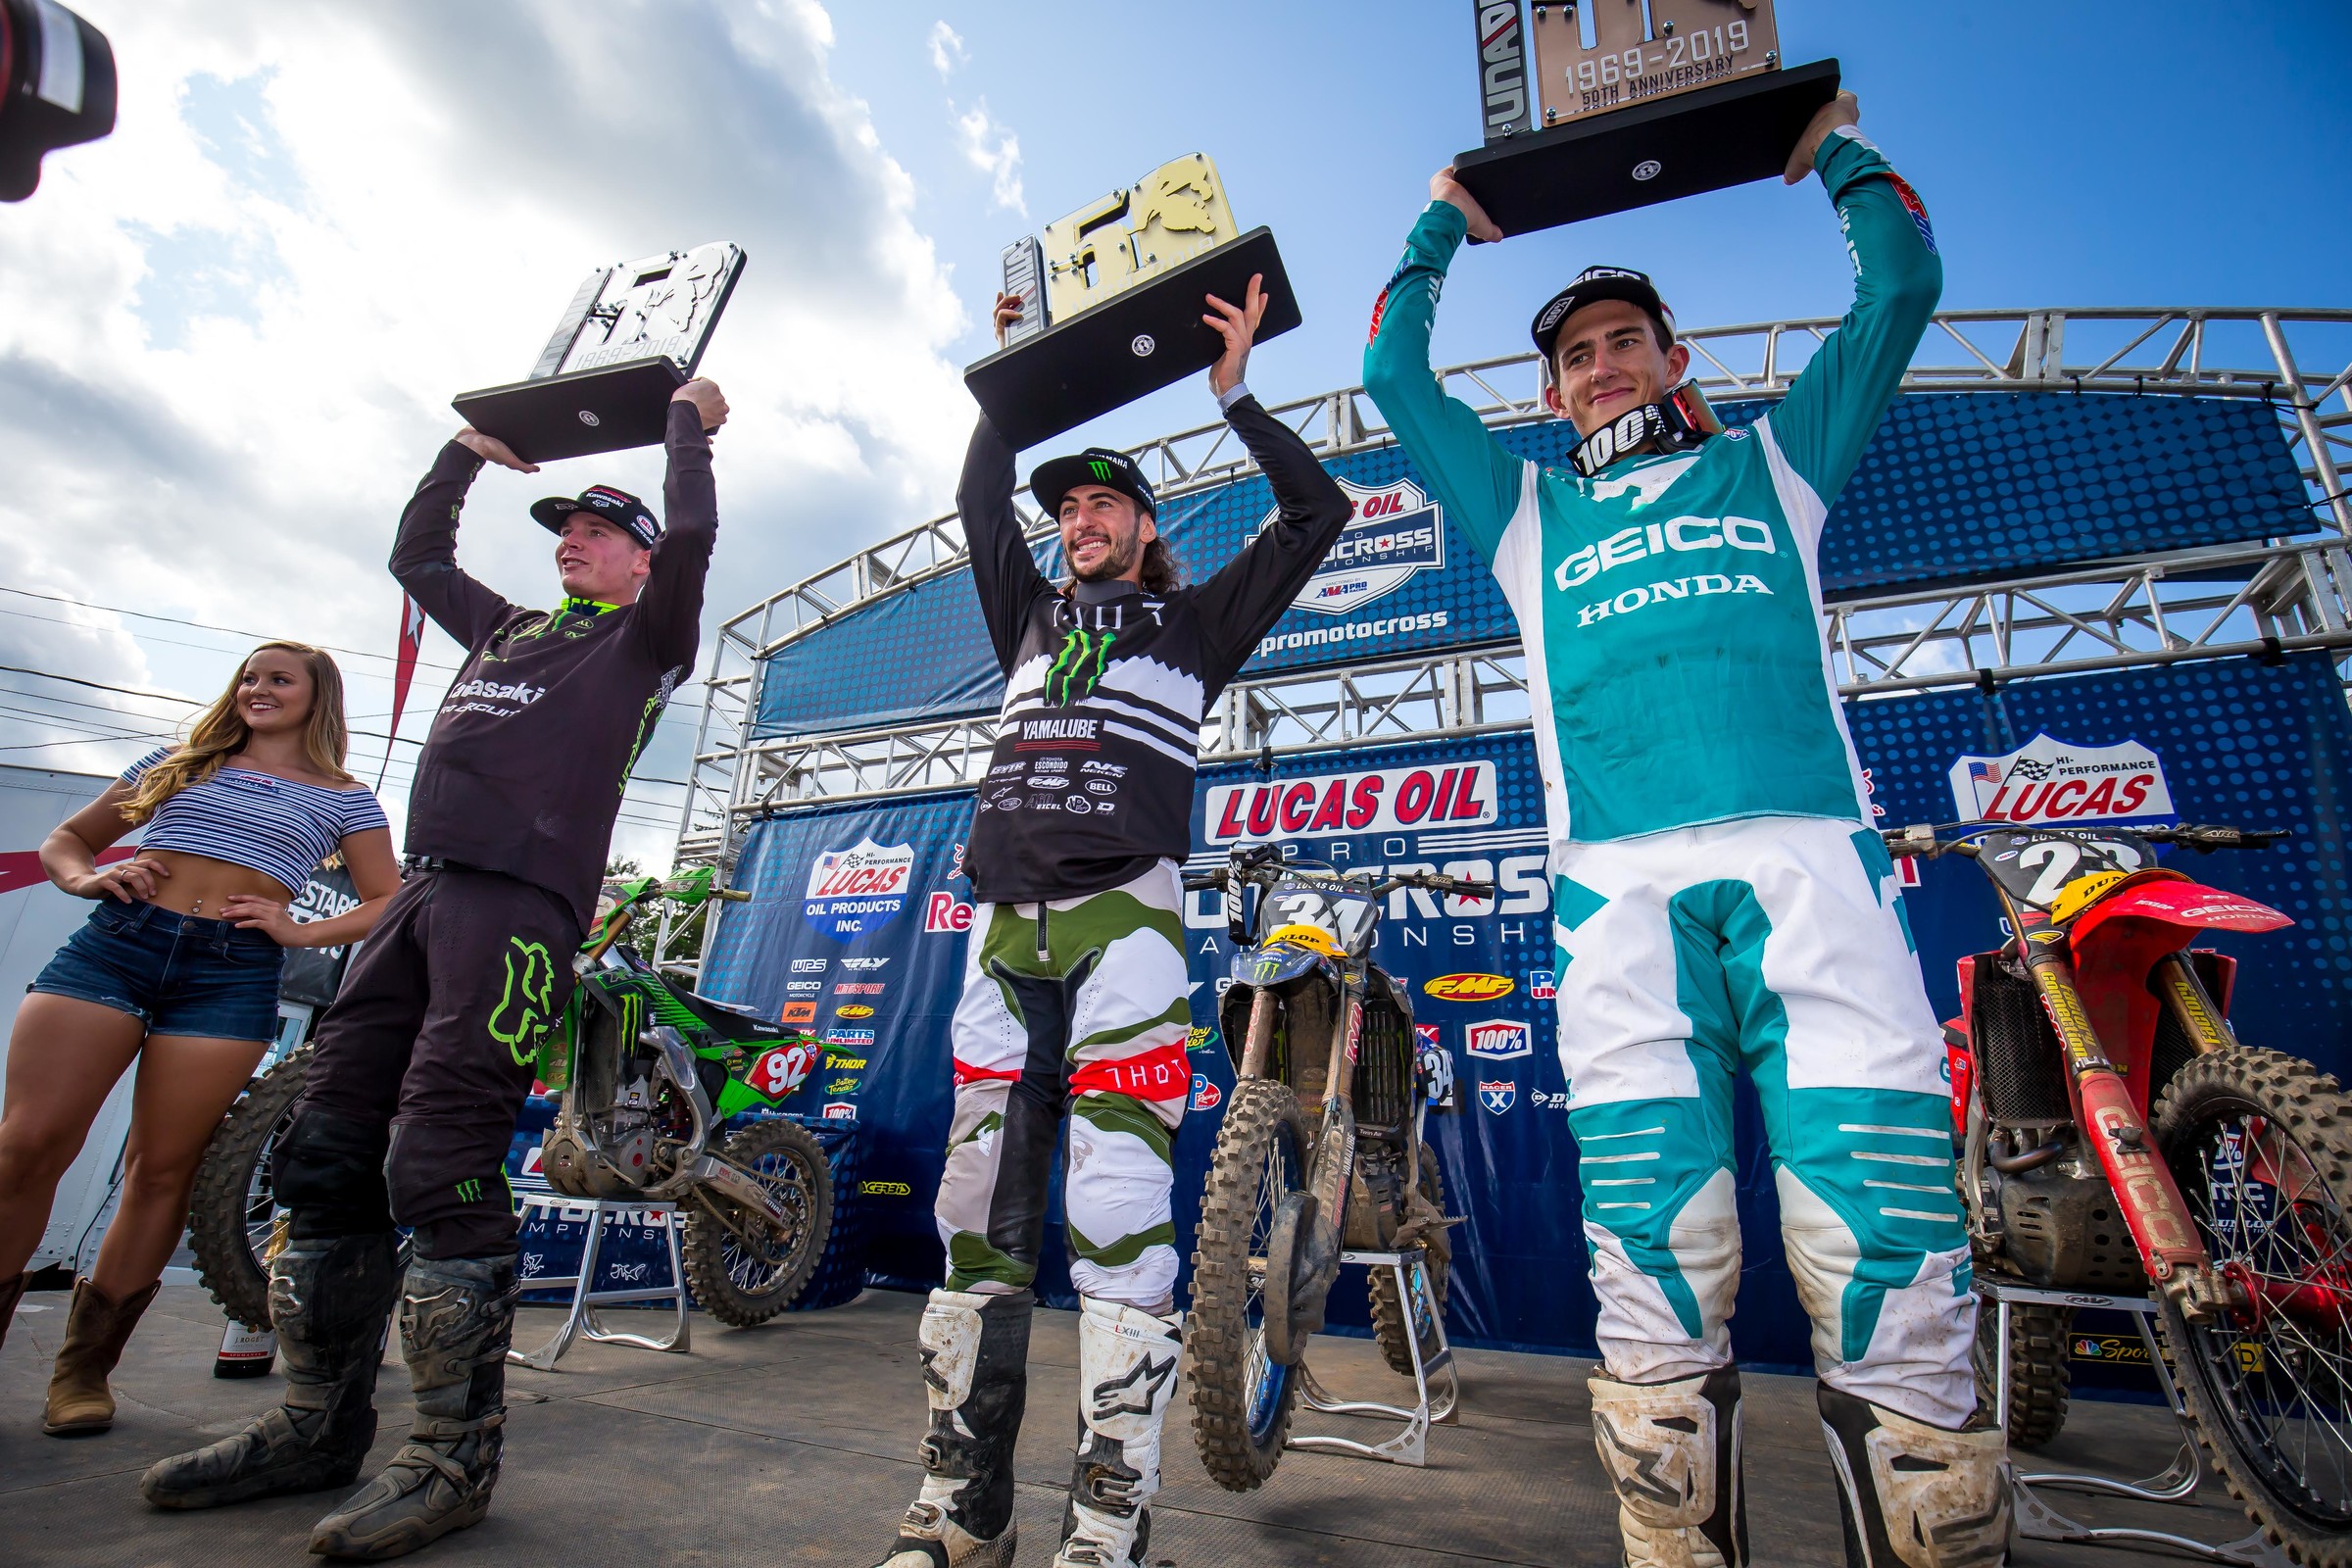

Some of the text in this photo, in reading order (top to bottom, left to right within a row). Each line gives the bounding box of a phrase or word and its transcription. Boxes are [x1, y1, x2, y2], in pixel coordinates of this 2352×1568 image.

[1480, 0, 1526, 125] UNAD
[1565, 20, 1748, 94] 1969-2019
[1583, 55, 1734, 105] 50TH ANNIVERSARY
[1577, 404, 1667, 476] 100%
[1362, 492, 1403, 519] OIL
[1554, 515, 1776, 592] GEICO
[1577, 573, 1775, 628] HONDA
[1023, 719, 1098, 740] YAMALUBE
[1034, 760, 1068, 769] ESCONDIDO
[2056, 757, 2074, 765] HI-
[2059, 760, 2156, 775] PERFORMANCE
[1089, 782, 1112, 792] BELL
[1982, 773, 2155, 821] LUCAS
[1215, 766, 1485, 839] LUCAS OIL
[2078, 832, 2101, 841] OIL
[815, 866, 906, 896] LUCAS
[806, 900, 901, 915] OIL PRODUCTS
[927, 893, 974, 931] Re
[2180, 905, 2281, 918] GEICO
[836, 920, 862, 932] INC.
[1270, 893, 1368, 952] 34
[791, 957, 890, 973] WPS FLY
[1425, 977, 1514, 995] FMF
[787, 1007, 874, 1017] KTM FMF
[828, 1029, 874, 1038] PARTS
[1475, 1029, 1523, 1051] 100%
[767, 1048, 807, 1094] 92
[835, 1059, 867, 1069] THOR
[1424, 1049, 1454, 1100] 34
[1490, 1092, 1508, 1108] X
[1343, 1132, 1356, 1176] YAMALUBE
[2095, 1105, 2188, 1249] GEICO
[1114, 1324, 1140, 1338] LXIII
